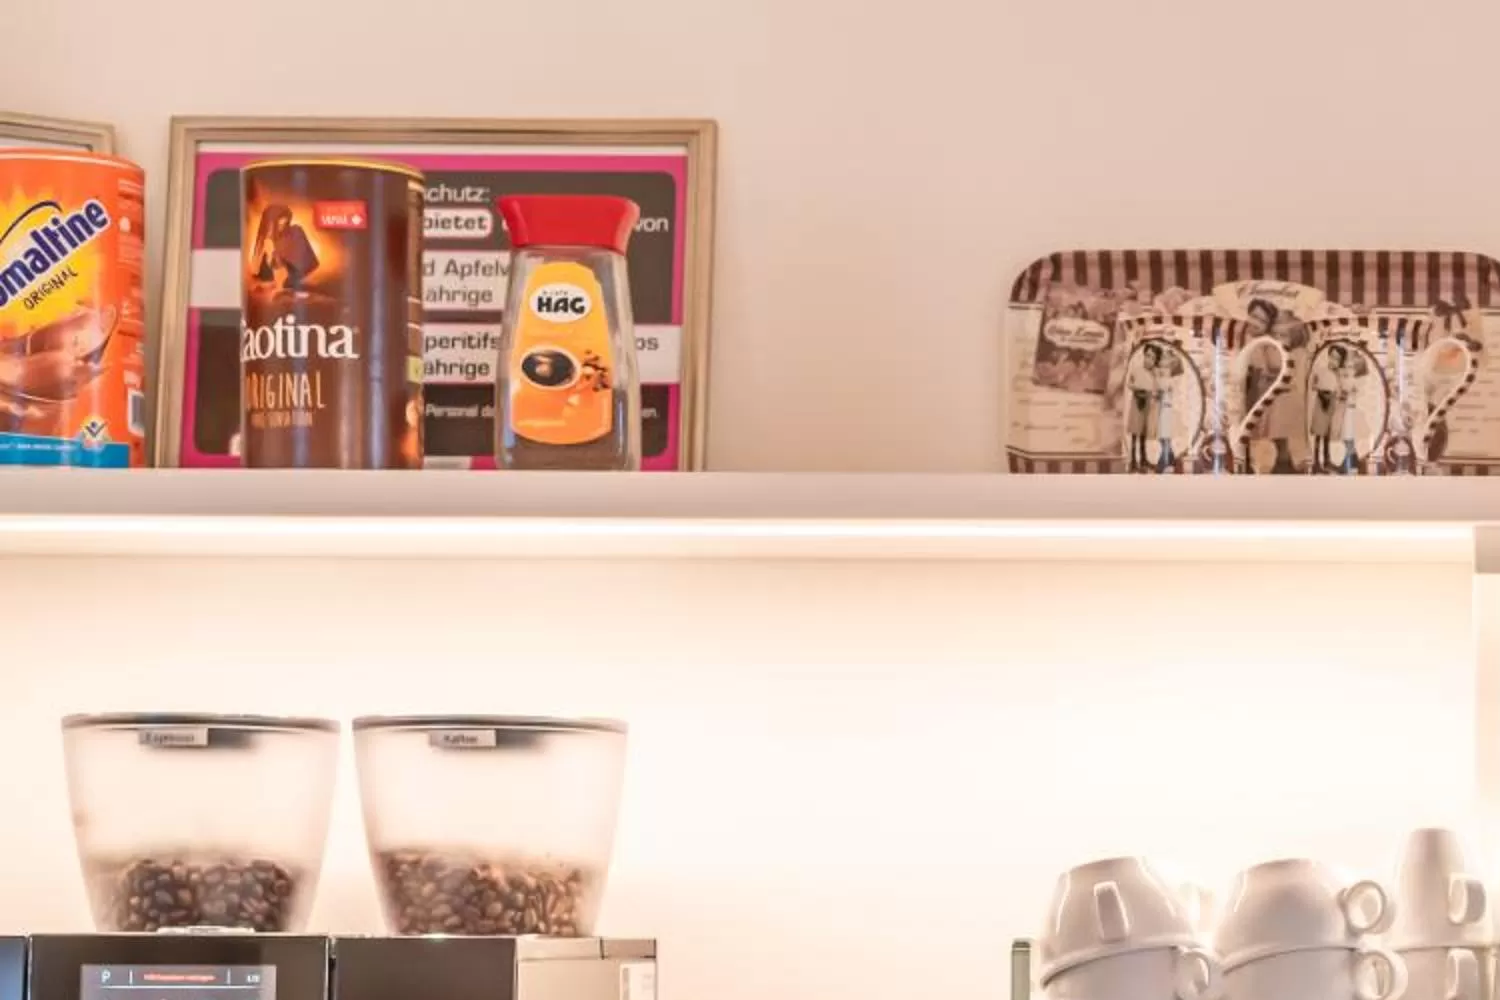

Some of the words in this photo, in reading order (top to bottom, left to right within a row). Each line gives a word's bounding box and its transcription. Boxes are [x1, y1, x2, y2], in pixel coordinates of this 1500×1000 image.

[23, 263, 79, 310] ORIGINAL
[537, 296, 585, 314] HAG
[240, 313, 360, 362] aotina
